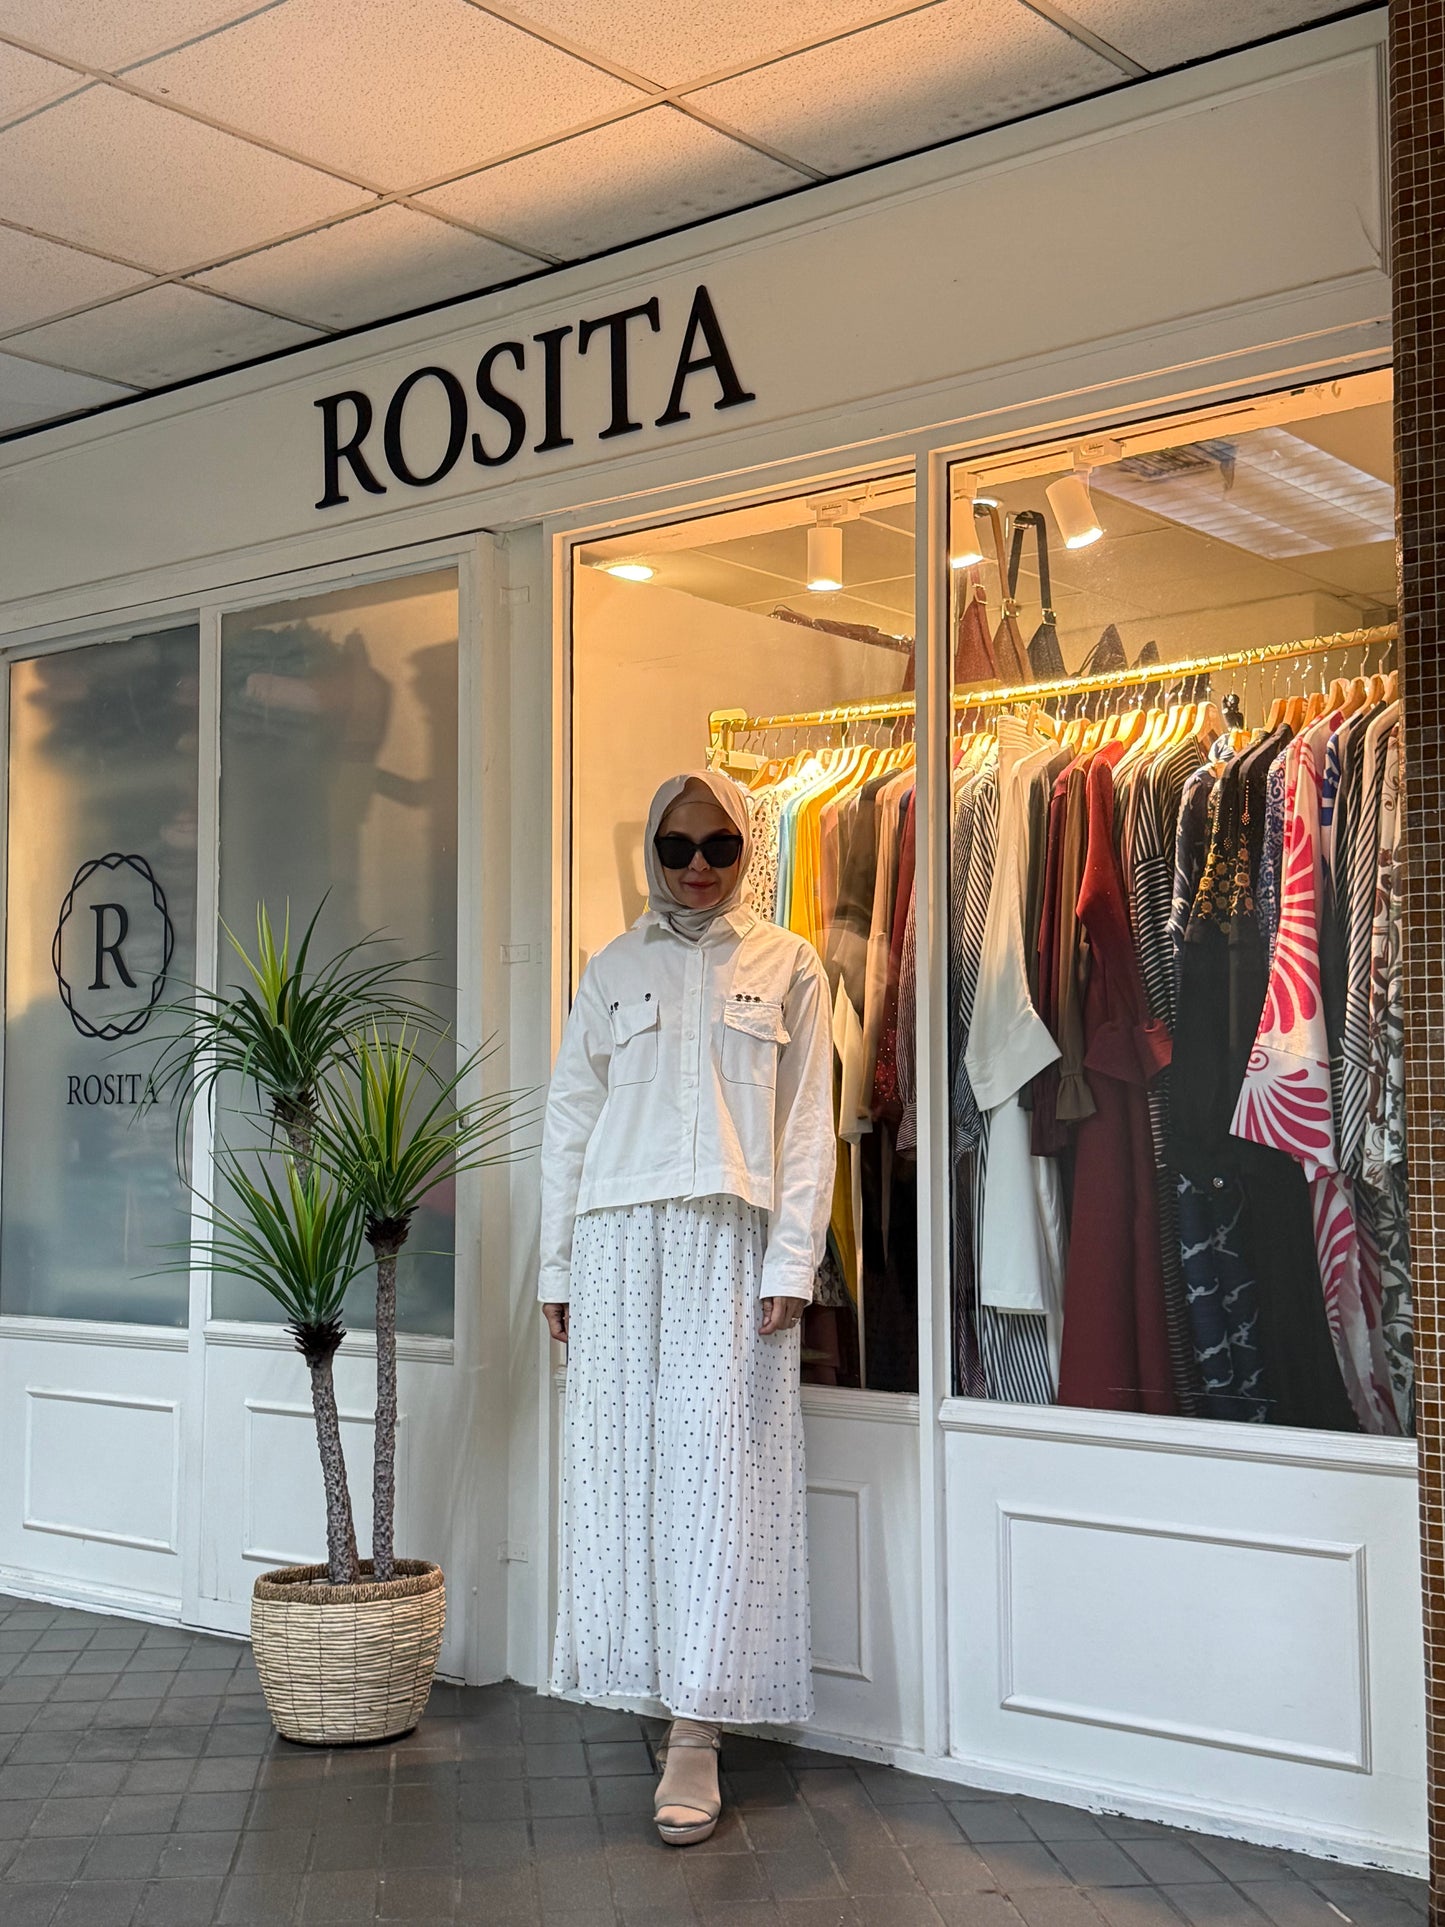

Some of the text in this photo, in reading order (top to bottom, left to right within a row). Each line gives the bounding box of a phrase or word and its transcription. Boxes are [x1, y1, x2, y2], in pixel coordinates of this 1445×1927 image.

[313, 284, 756, 510] ROSITA
[88, 903, 137, 990] R
[66, 1073, 159, 1105] ROSITA
